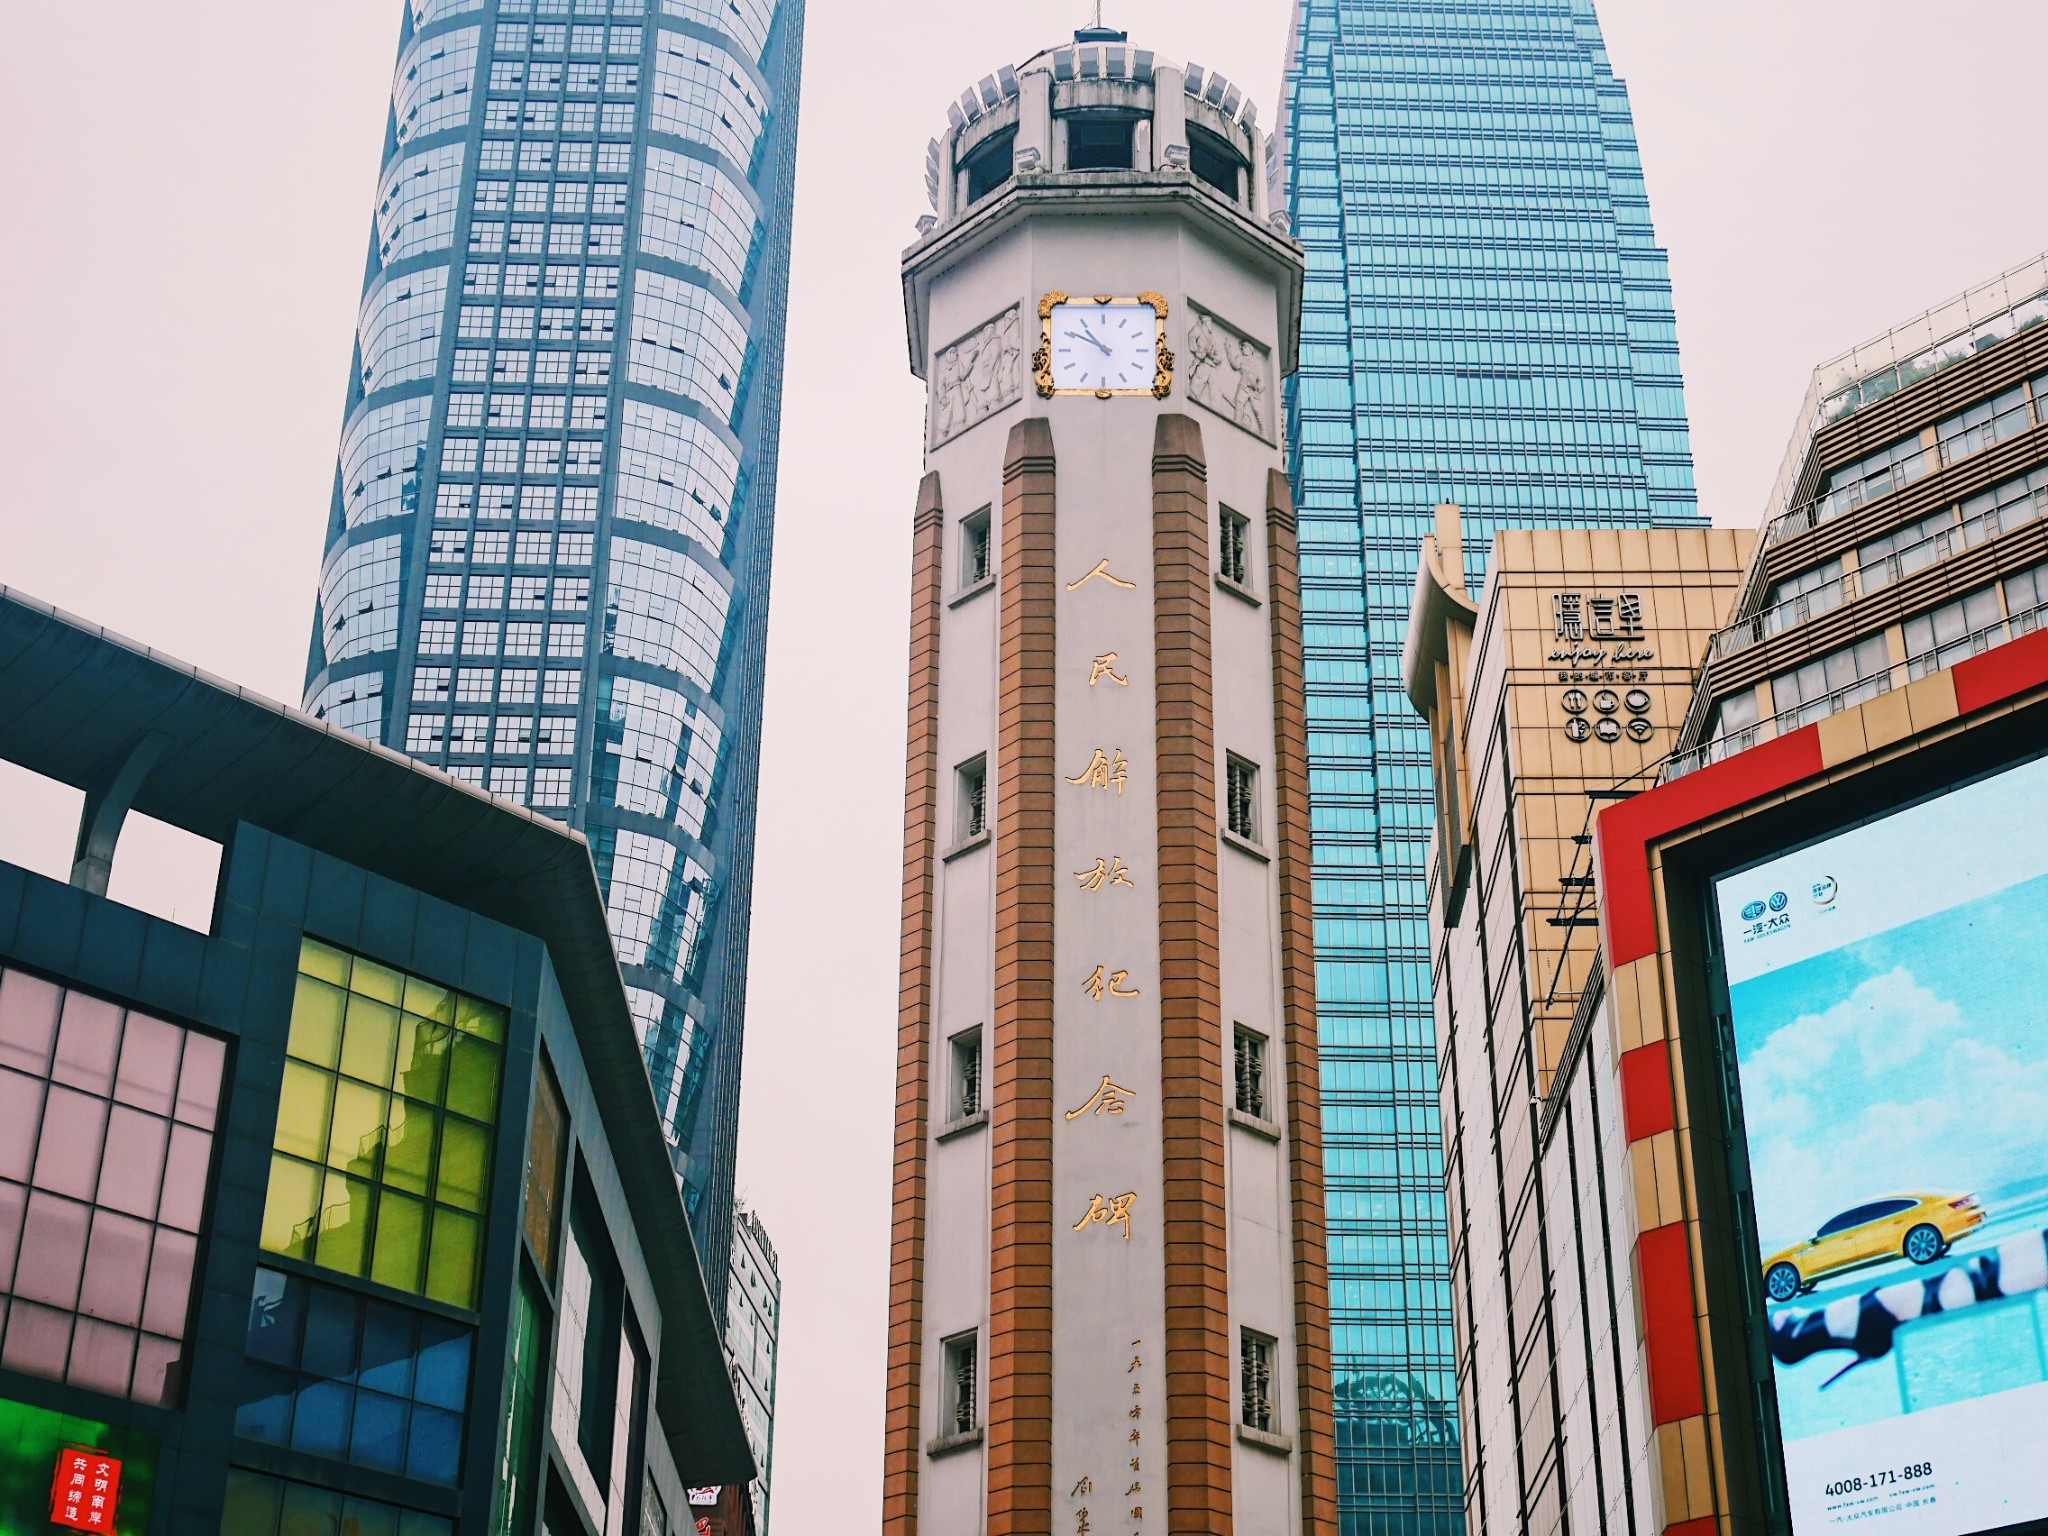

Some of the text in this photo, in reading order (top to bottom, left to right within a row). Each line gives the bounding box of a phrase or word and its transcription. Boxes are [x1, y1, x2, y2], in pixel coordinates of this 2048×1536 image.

[1548, 642, 1654, 668] enjoy here
[1825, 1461, 1933, 1497] 4008-171-888
